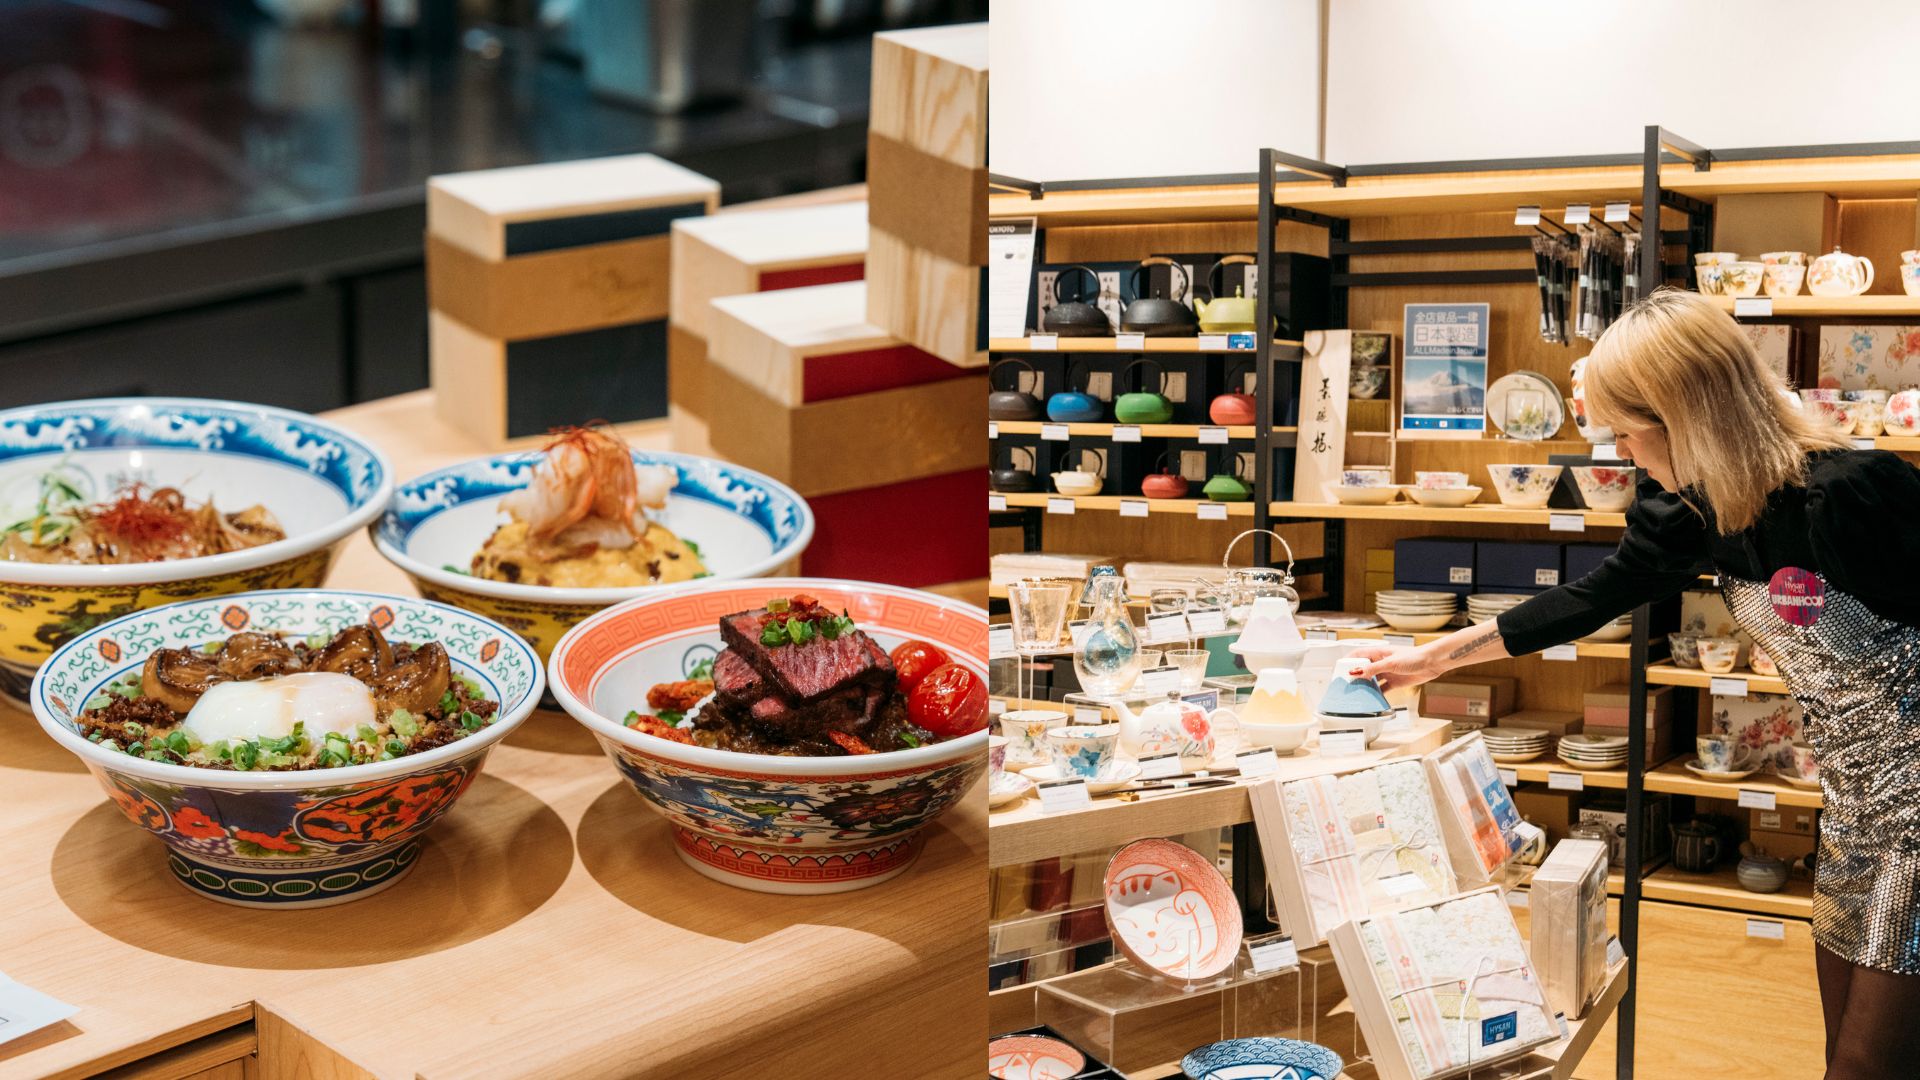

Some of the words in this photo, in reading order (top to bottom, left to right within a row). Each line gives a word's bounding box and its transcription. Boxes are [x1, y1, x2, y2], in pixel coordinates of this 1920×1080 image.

[1416, 326, 1477, 343] 日本製造
[1771, 594, 1824, 607] URBANHOOD
[1489, 1021, 1511, 1035] HYSAN
